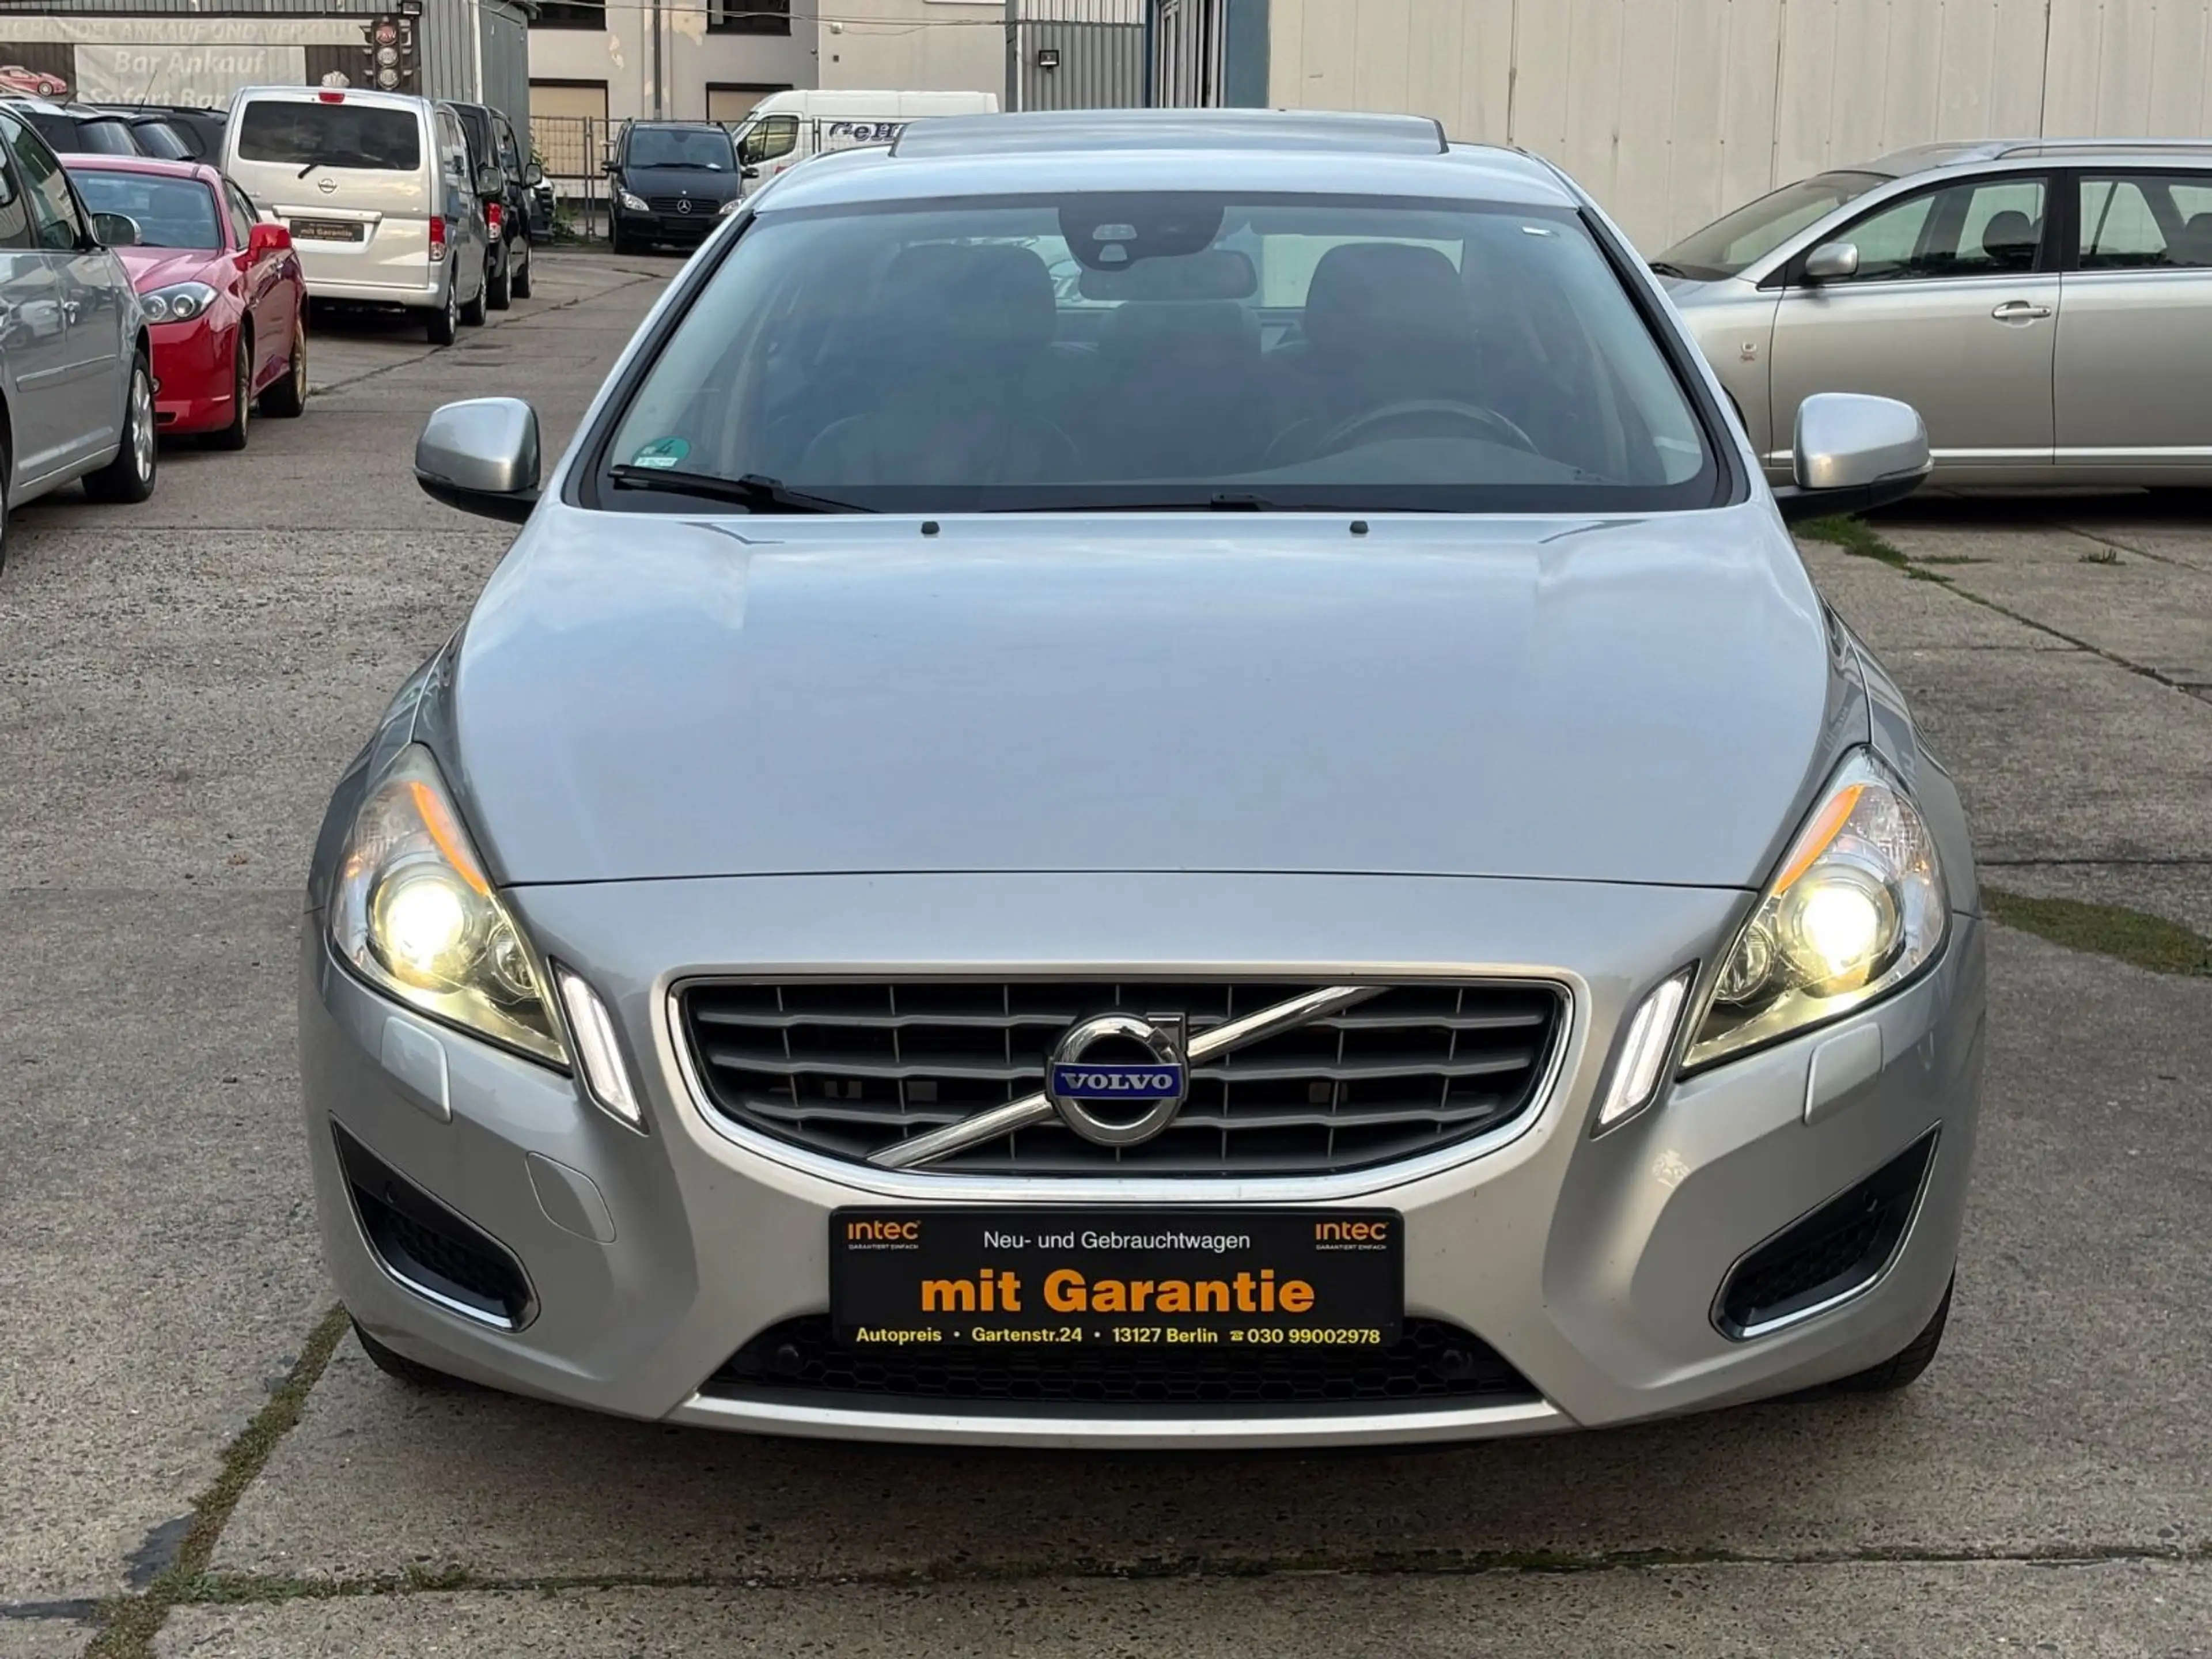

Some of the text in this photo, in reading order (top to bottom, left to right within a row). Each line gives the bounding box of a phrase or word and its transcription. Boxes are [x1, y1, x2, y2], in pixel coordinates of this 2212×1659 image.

[118, 22, 209, 40] ANKAUF
[211, 22, 257, 40] UND
[114, 48, 267, 74] Bar Ankauf
[89, 86, 228, 107] Sofort Bar
[1060, 1072, 1173, 1090] VOLVO
[984, 1232, 1250, 1253] Neu- und Gebrauchtwagen
[921, 1268, 1315, 1313] mit Garantie
[856, 1327, 1381, 1346] Autopreis Gartenstr.24 13127 Berlin 030 99002978
